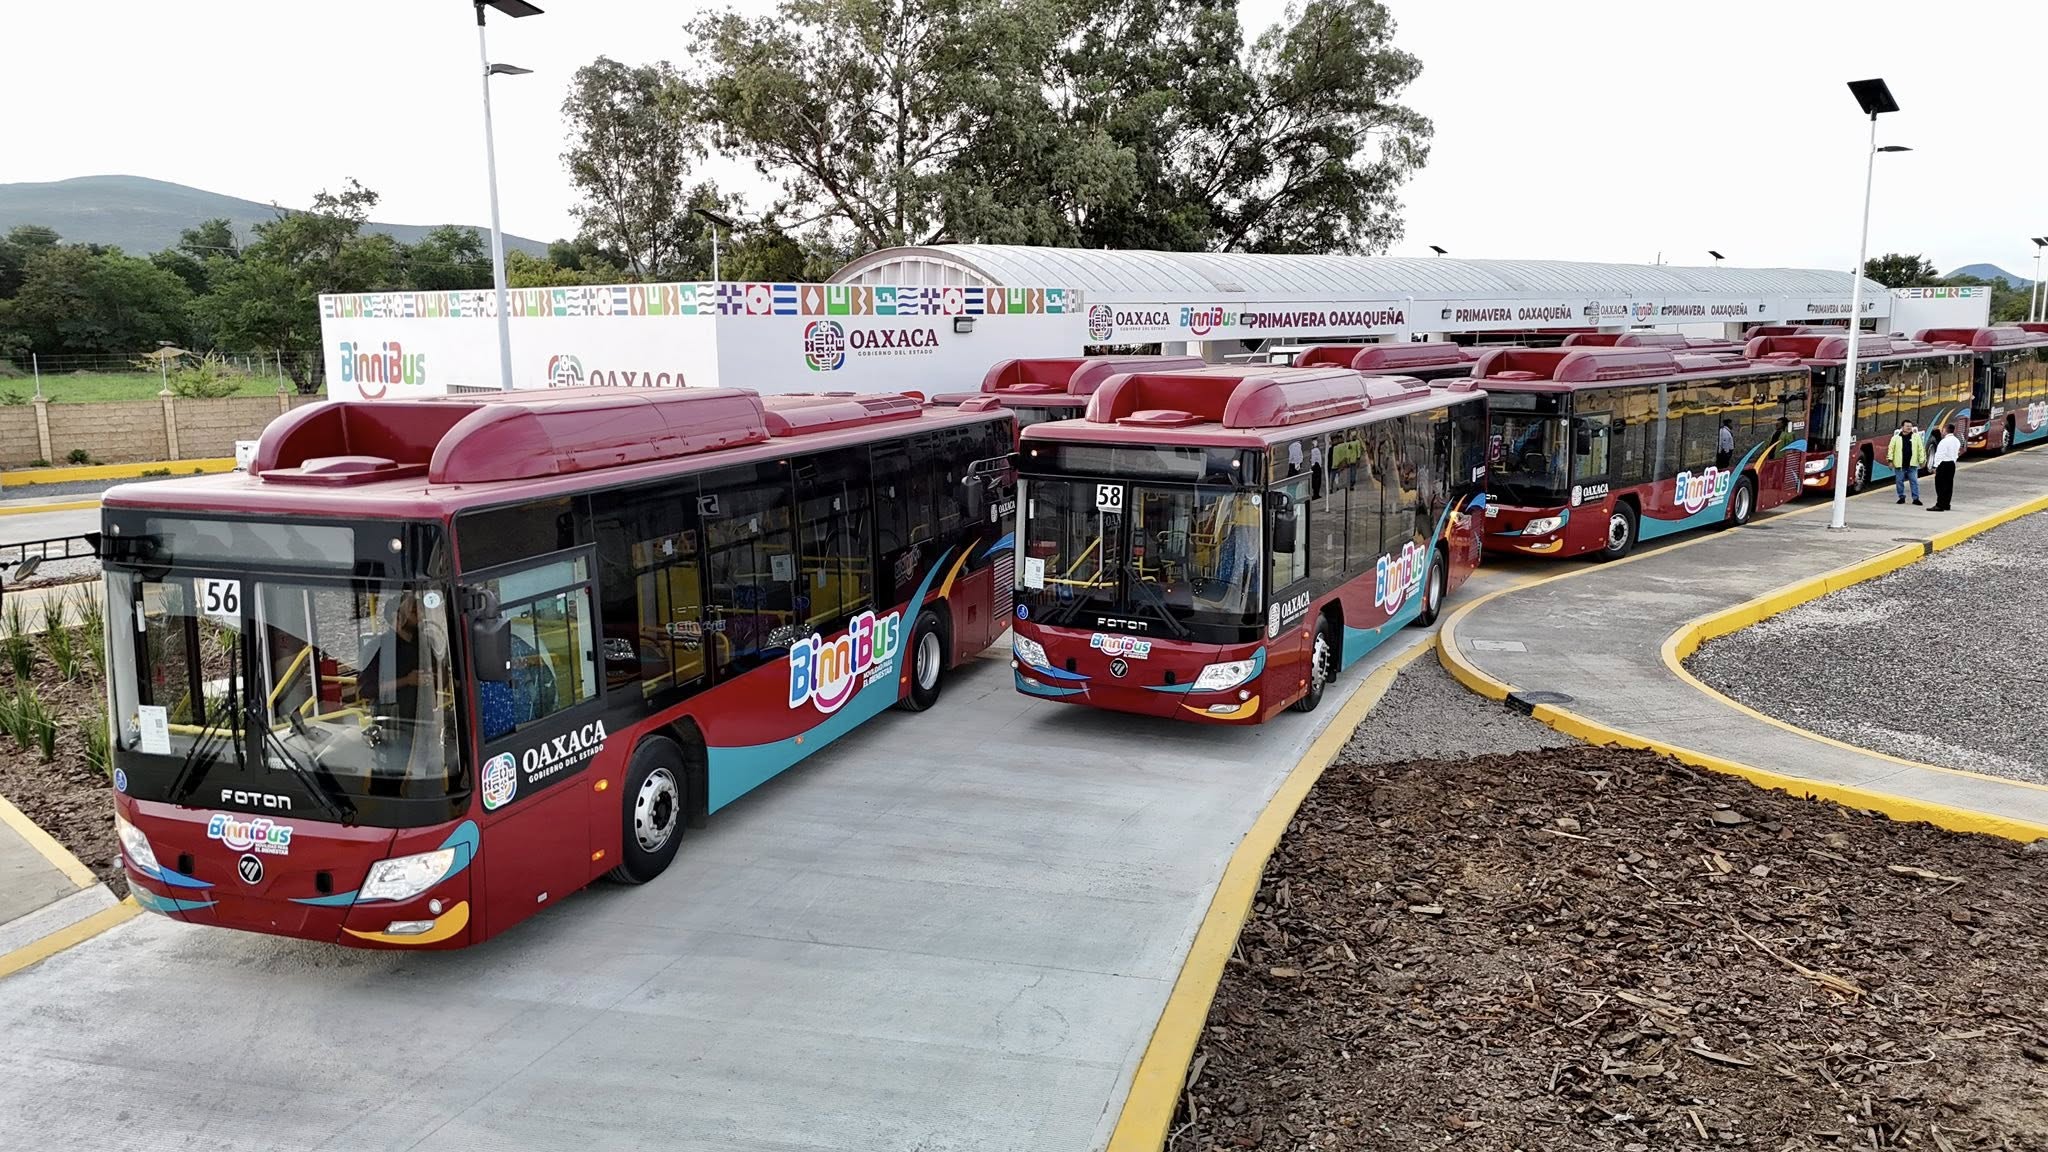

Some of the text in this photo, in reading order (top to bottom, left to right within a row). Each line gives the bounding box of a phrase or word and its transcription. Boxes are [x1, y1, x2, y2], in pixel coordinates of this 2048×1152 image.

[1115, 311, 1171, 326] OAXACA
[1180, 307, 1236, 328] BinniBus
[1249, 306, 1405, 329] PRIMAVERA OAXAQUEÑA
[1456, 304, 1572, 322] PRIMAVERA OAXAQUEÑA
[1600, 305, 1628, 315] OAXACA
[1668, 302, 1748, 317] PRIMAVERA OAXAQUEÑA
[849, 328, 940, 349] OAXACA
[340, 341, 426, 386] BinniBus
[1098, 485, 1120, 506] 58
[1582, 483, 1609, 497] OAXACA
[1674, 466, 1730, 506] BinniBus
[1375, 541, 1426, 608] BinniBus
[207, 581, 238, 613] 56
[1281, 590, 1310, 619] OAXACA
[1097, 617, 1148, 631] FOTON
[1090, 633, 1152, 654] BinniBus
[790, 611, 899, 709] BinniBus
[522, 719, 608, 774] OAXACA
[528, 743, 604, 784] GOBIERNO DEL ESTADO
[221, 789, 292, 811] FOTON
[207, 814, 294, 846] BinniBus
